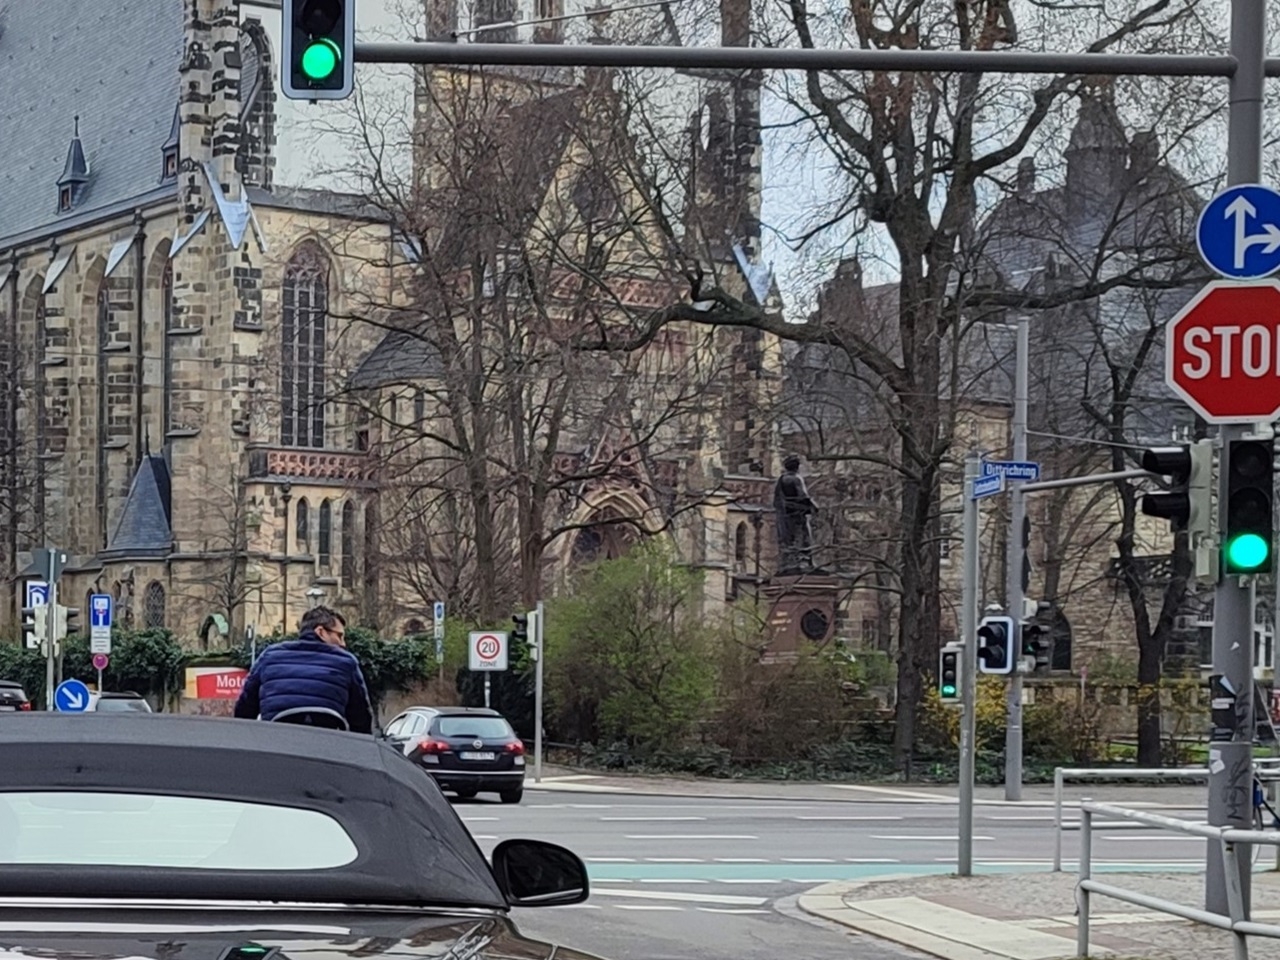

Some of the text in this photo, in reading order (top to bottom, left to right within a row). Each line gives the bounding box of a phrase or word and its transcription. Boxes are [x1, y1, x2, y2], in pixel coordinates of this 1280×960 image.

[1182, 324, 1280, 379] STO
[986, 463, 1037, 480] Dittrichring
[481, 641, 496, 653] 20
